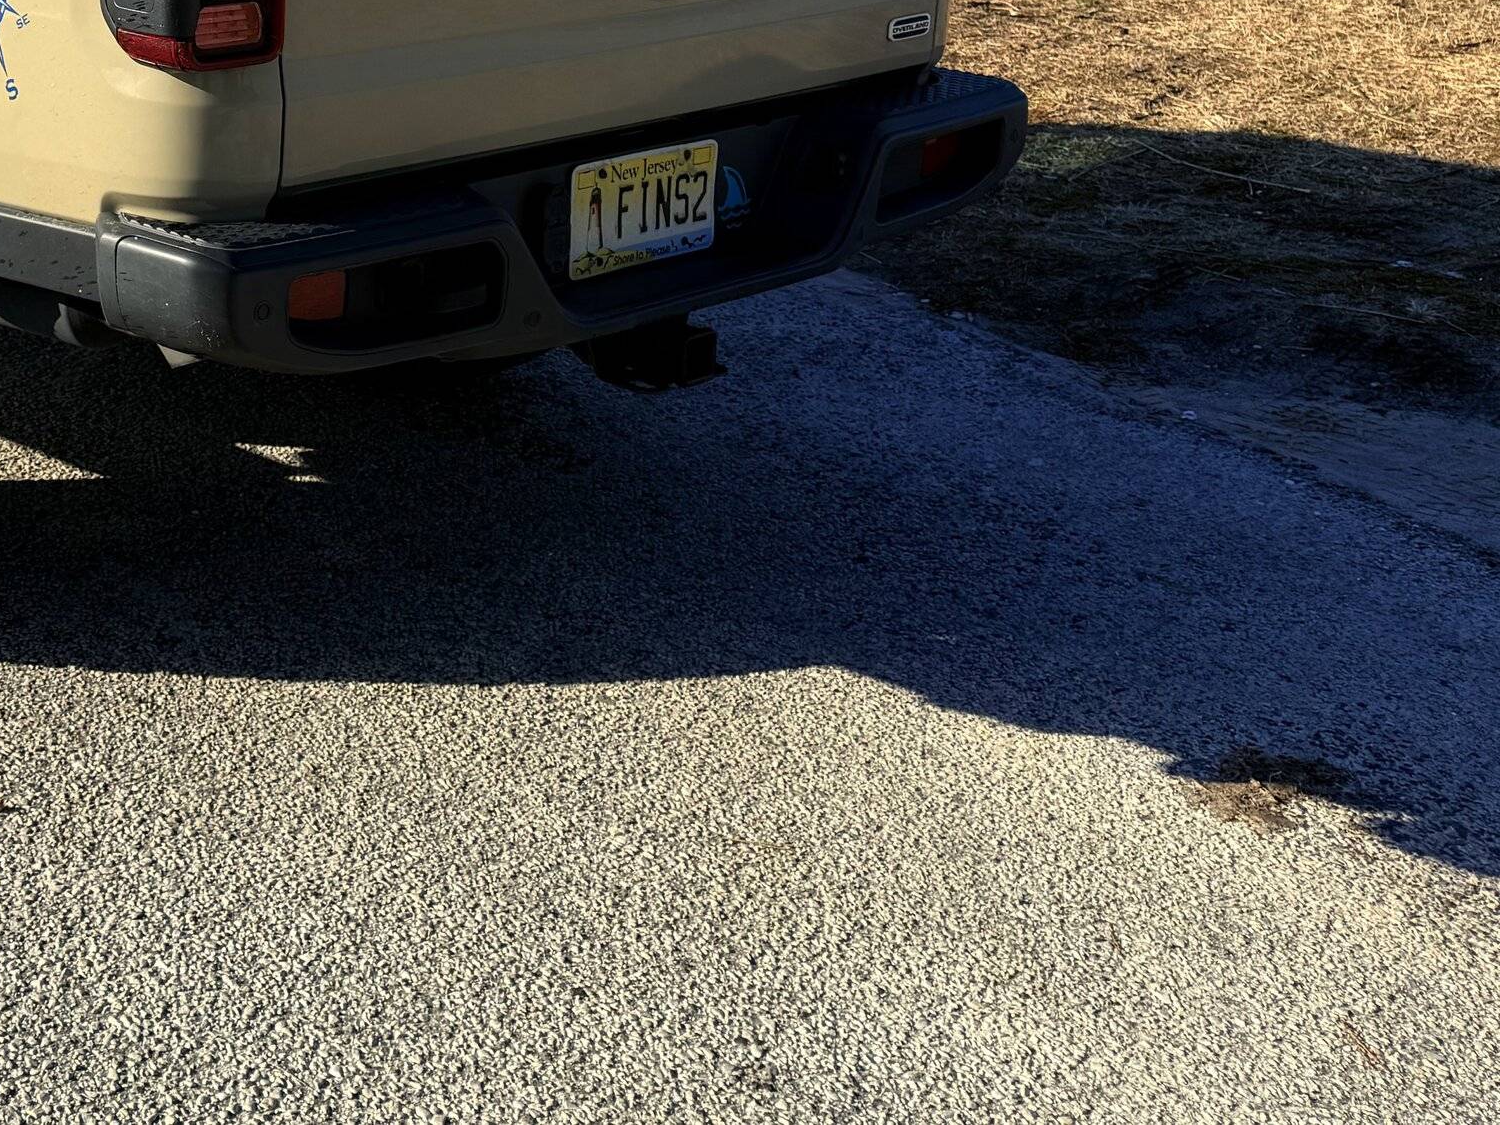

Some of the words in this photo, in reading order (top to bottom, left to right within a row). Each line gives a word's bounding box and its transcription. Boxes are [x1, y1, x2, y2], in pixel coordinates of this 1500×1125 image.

[16, 14, 31, 29] SE
[892, 21, 929, 34] OVERLAND
[5, 79, 19, 101] S
[611, 164, 639, 183] New
[642, 158, 678, 181] Jersey
[617, 171, 708, 239] FINS2
[613, 251, 634, 266] Shore
[636, 249, 644, 260] to
